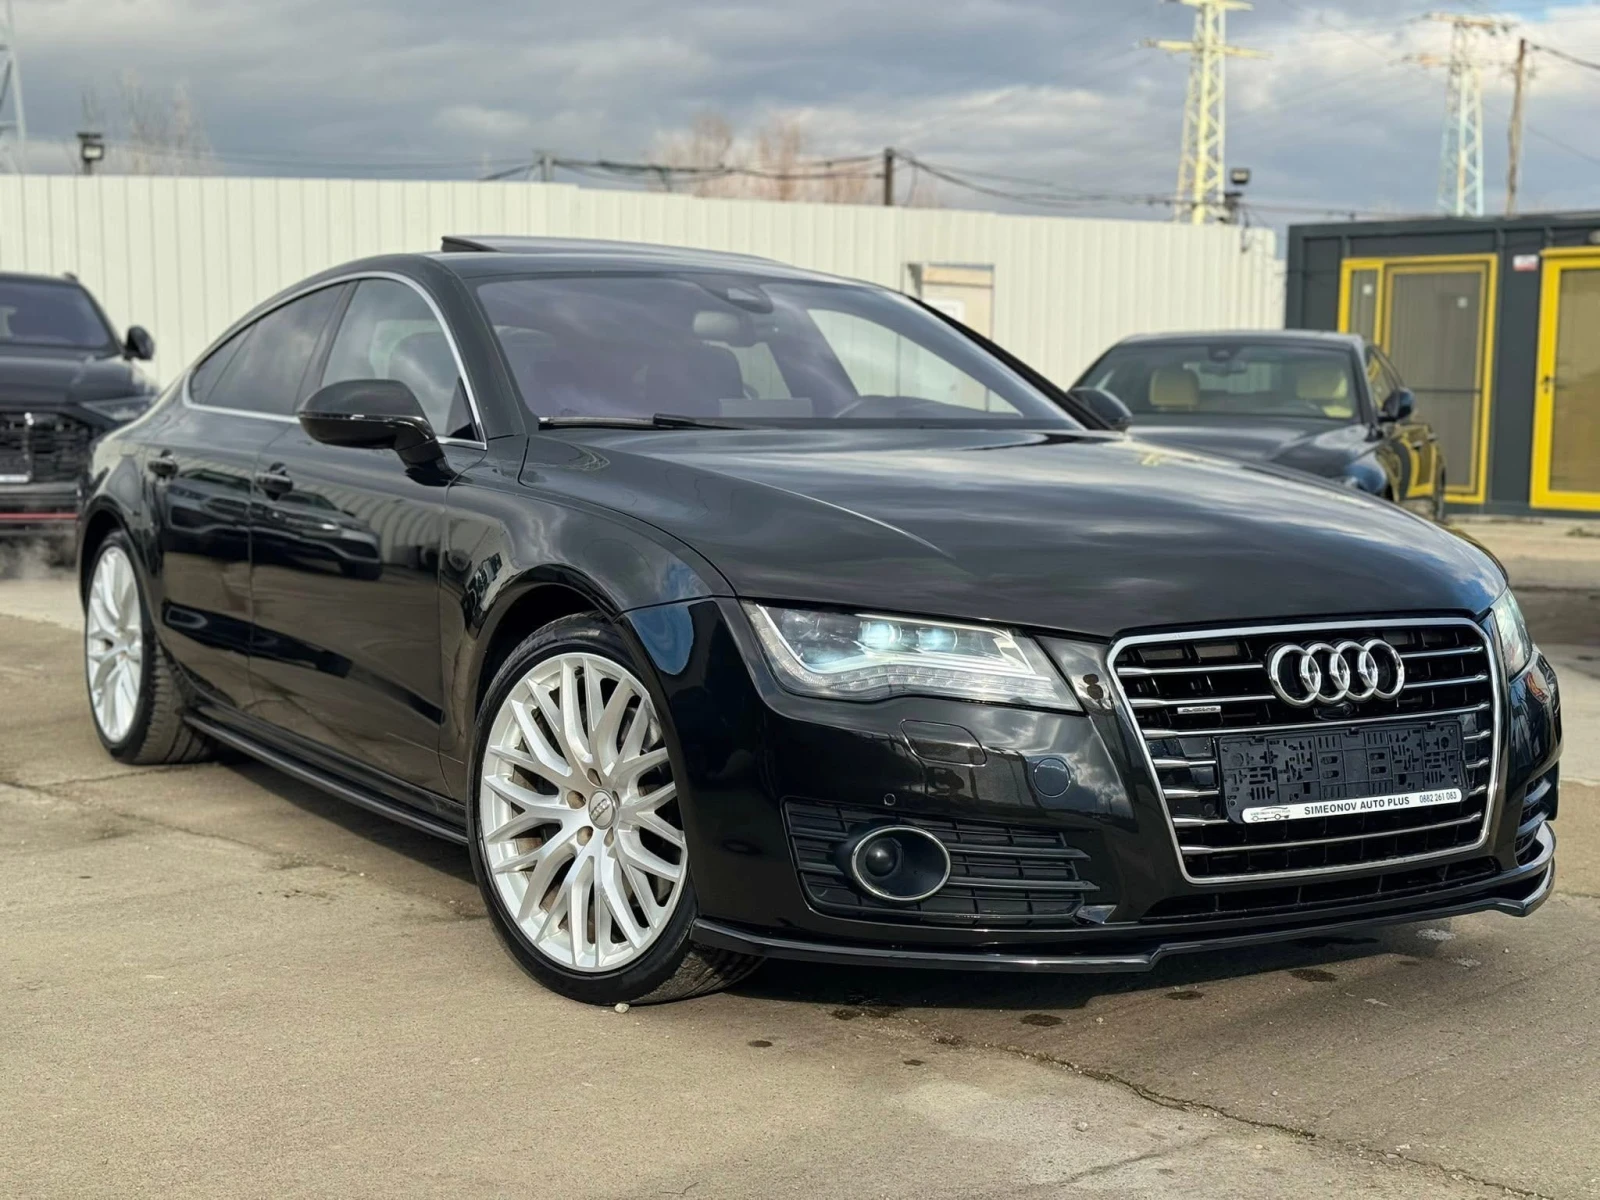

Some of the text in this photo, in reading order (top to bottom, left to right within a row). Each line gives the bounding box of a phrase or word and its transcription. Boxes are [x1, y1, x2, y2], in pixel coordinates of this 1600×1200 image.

[1304, 802, 1357, 815] SIMEONOV
[1360, 798, 1385, 809] AUTO
[1387, 796, 1410, 807] PLUS
